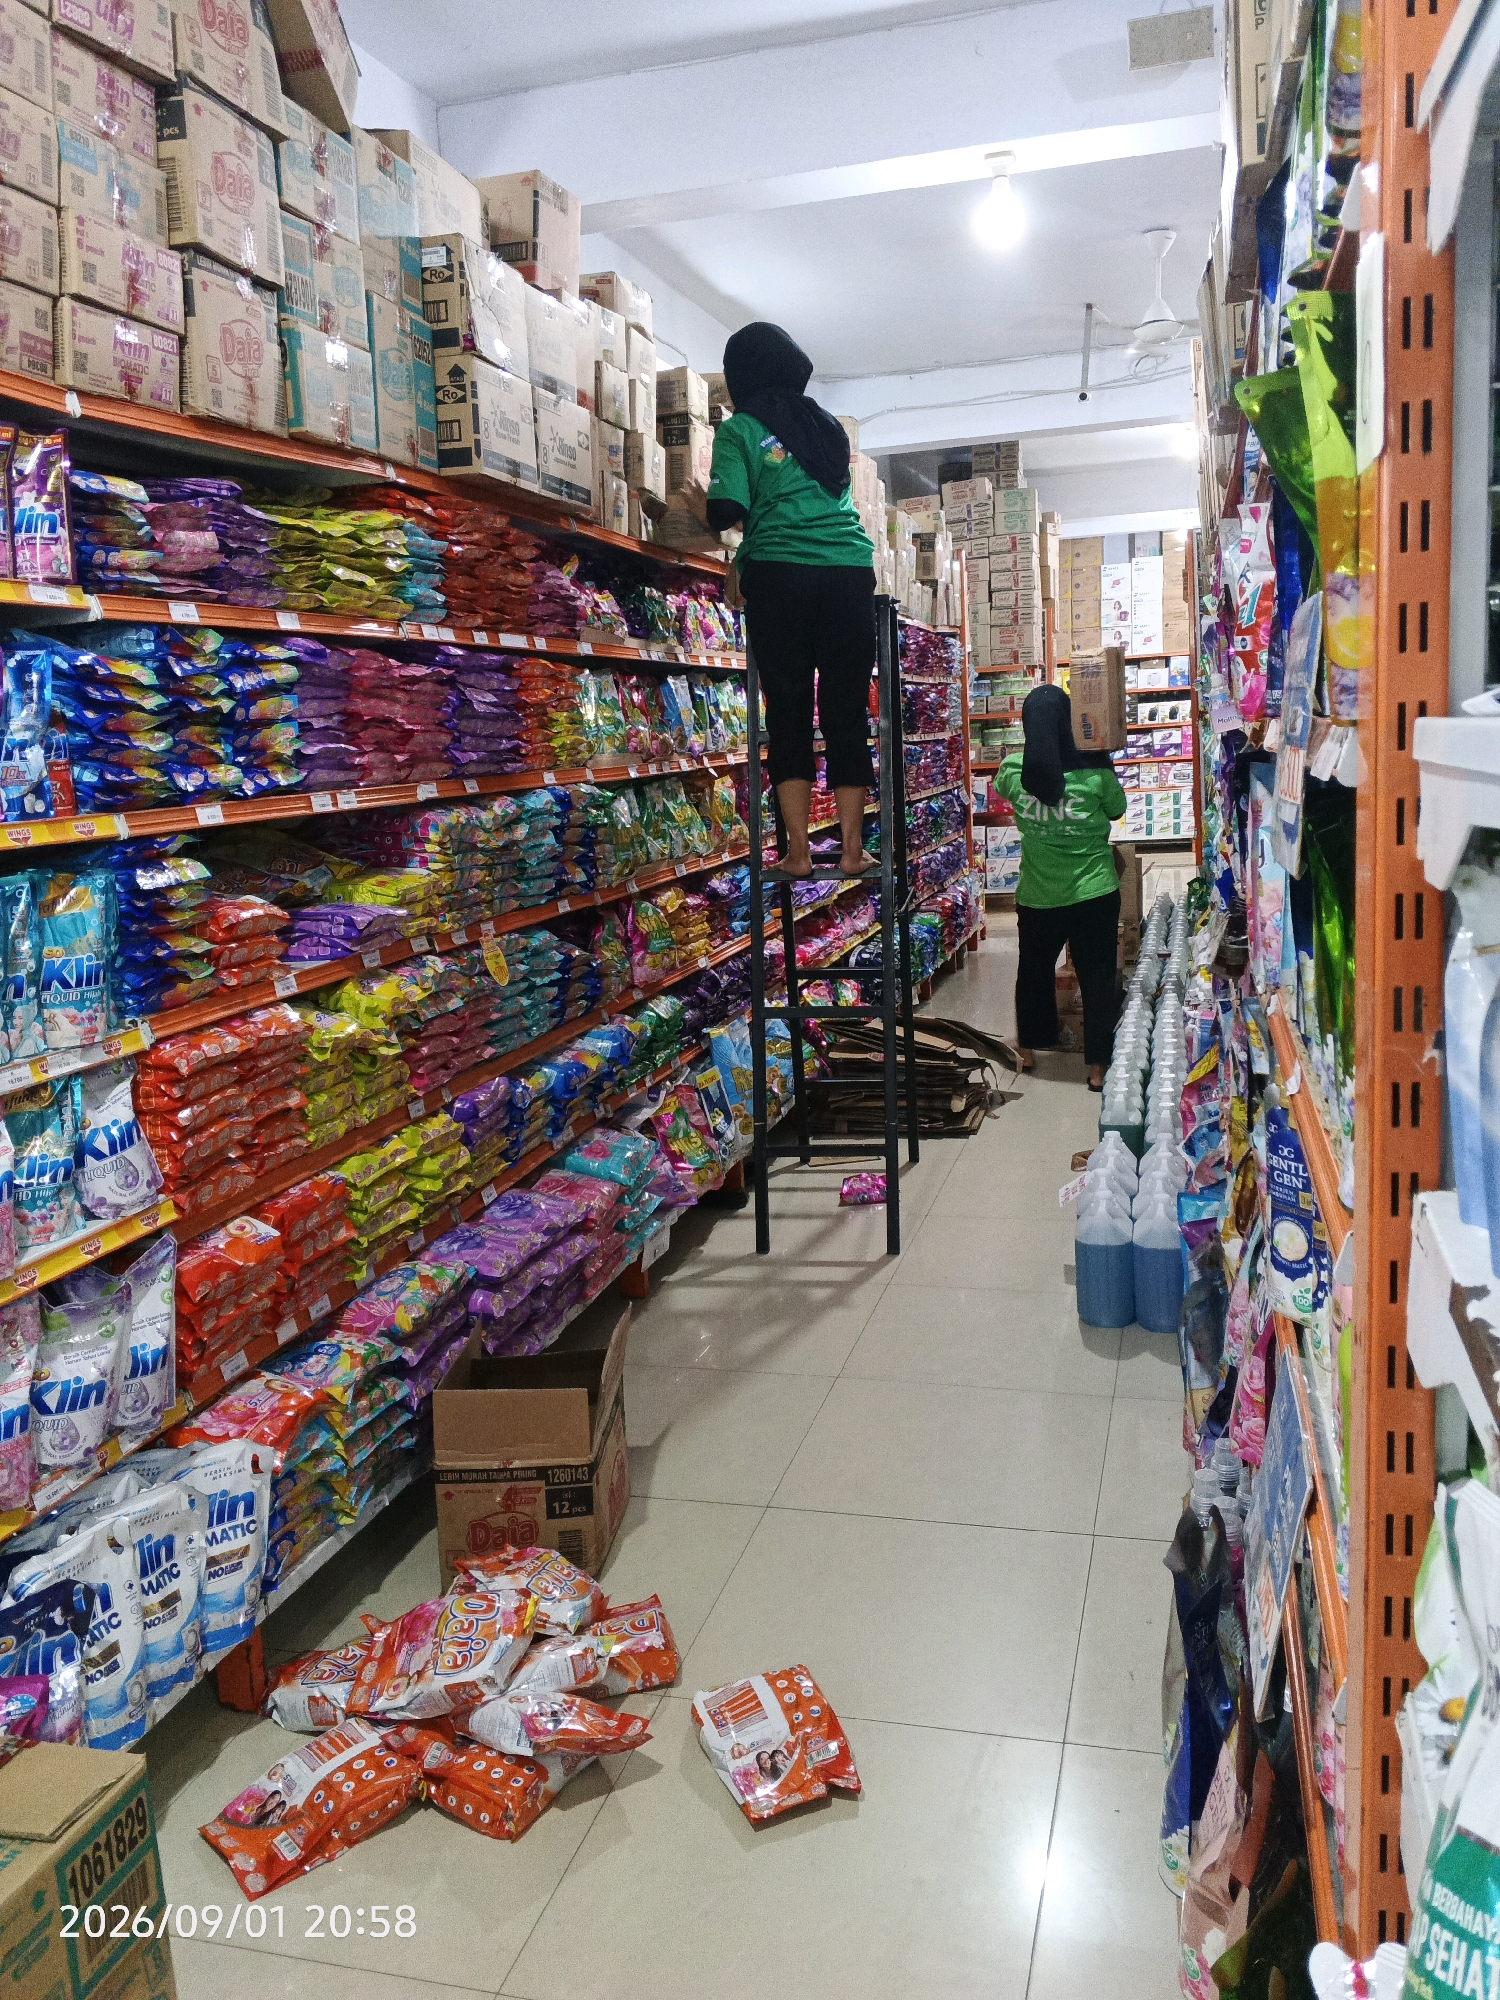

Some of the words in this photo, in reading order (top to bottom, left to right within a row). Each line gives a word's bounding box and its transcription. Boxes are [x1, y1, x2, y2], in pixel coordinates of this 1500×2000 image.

[429, 267, 445, 280] Ro
[152, 334, 177, 354] 80821
[220, 323, 263, 366] Daia
[443, 389, 458, 401] Ro
[15, 506, 60, 536] lin
[1018, 794, 1086, 822] ZINC
[7, 828, 31, 838] WINGS
[73, 821, 96, 832] WINGS
[41, 991, 81, 1004] LIQUID
[74, 1118, 141, 1170] Klin
[84, 1156, 126, 1183] LIQUID
[1267, 1153, 1308, 1177] GENTL
[1274, 1171, 1304, 1189] GEN
[139, 1210, 160, 1223] WINGS
[79, 1238, 101, 1253] WINGS
[12, 1268, 37, 1286] WINGS
[124, 1342, 169, 1381] lin
[29, 1375, 107, 1417] Klin
[32, 1418, 69, 1434] QUID
[439, 1471, 461, 1481] LEBIH
[461, 1471, 488, 1481] MURAH
[547, 1467, 589, 1484] 1260143
[207, 1488, 256, 1531] lin
[553, 1502, 570, 1515] 12
[572, 1504, 587, 1515] pcs
[205, 1519, 258, 1548] MATIC
[467, 1515, 539, 1555] Daia
[134, 1533, 175, 1580] lin
[207, 1567, 225, 1582] NO
[143, 1616, 162, 1631] NO
[434, 1592, 501, 1677] Daia
[85, 1672, 103, 1686] NO
[69, 1796, 149, 1908] 1061829
[1425, 1922, 1500, 2000] SEHAT
